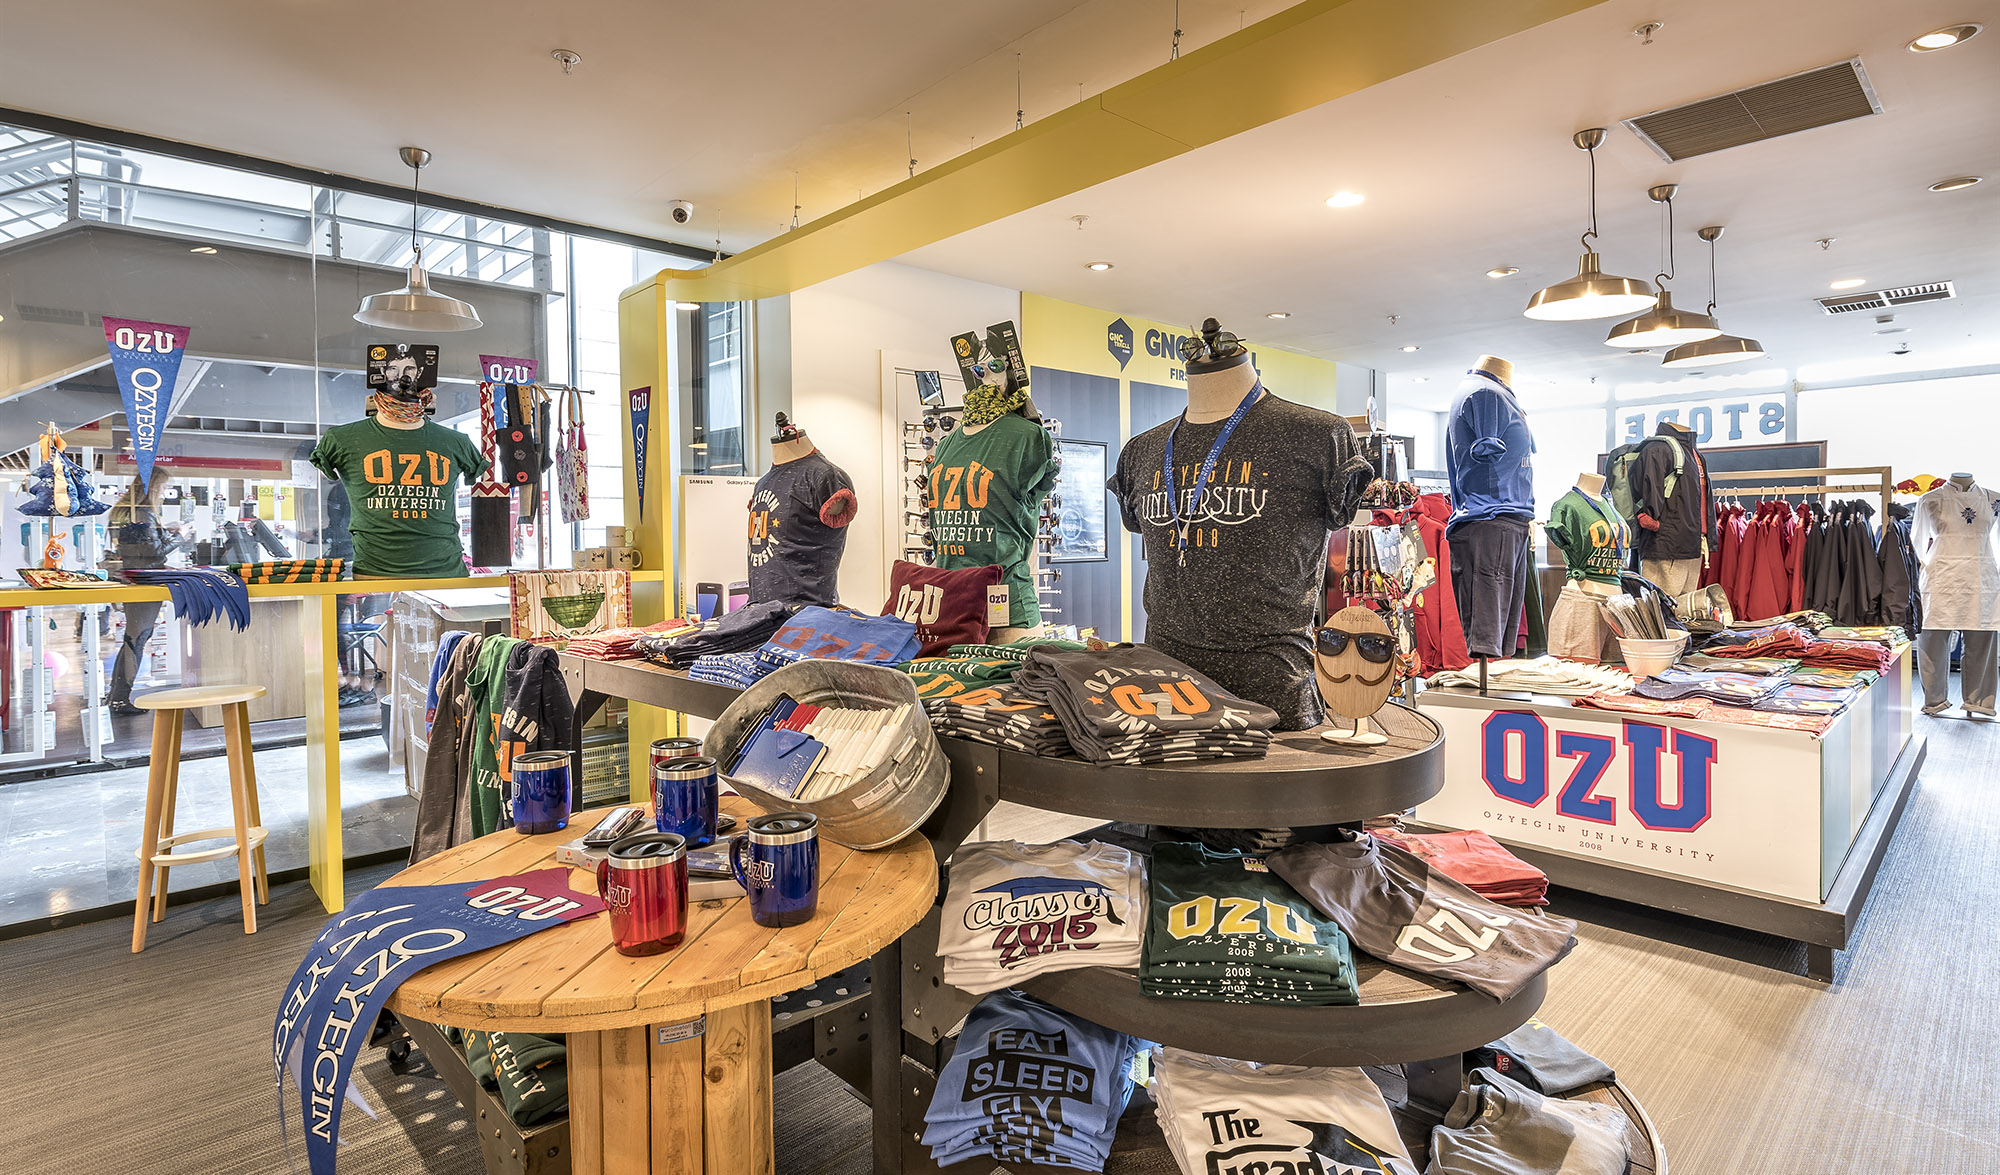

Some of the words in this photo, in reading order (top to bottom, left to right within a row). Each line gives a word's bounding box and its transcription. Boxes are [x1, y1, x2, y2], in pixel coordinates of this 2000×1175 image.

[131, 367, 162, 452] OZYEGIN
[1153, 459, 1252, 490] OYEGIN
[378, 485, 439, 498] OZYEGIN
[367, 497, 447, 510] UNIVERSITY
[392, 510, 428, 520] 2008
[934, 510, 981, 525] YEGIN
[1169, 528, 1218, 547] 208
[1483, 809, 1567, 833] OZYEGIN
[1581, 828, 1716, 862] UNIVERSITY
[1579, 840, 1603, 851] 2008
[963, 892, 1068, 931] Class
[992, 912, 1098, 951] 2015
[1227, 947, 1255, 957] 2008
[1225, 967, 1251, 977] 2008
[311, 927, 467, 1144] OZYEGIN
[996, 1030, 1062, 1053] EAT
[971, 1059, 1089, 1093] SLEEP
[1202, 1108, 1263, 1146] The
